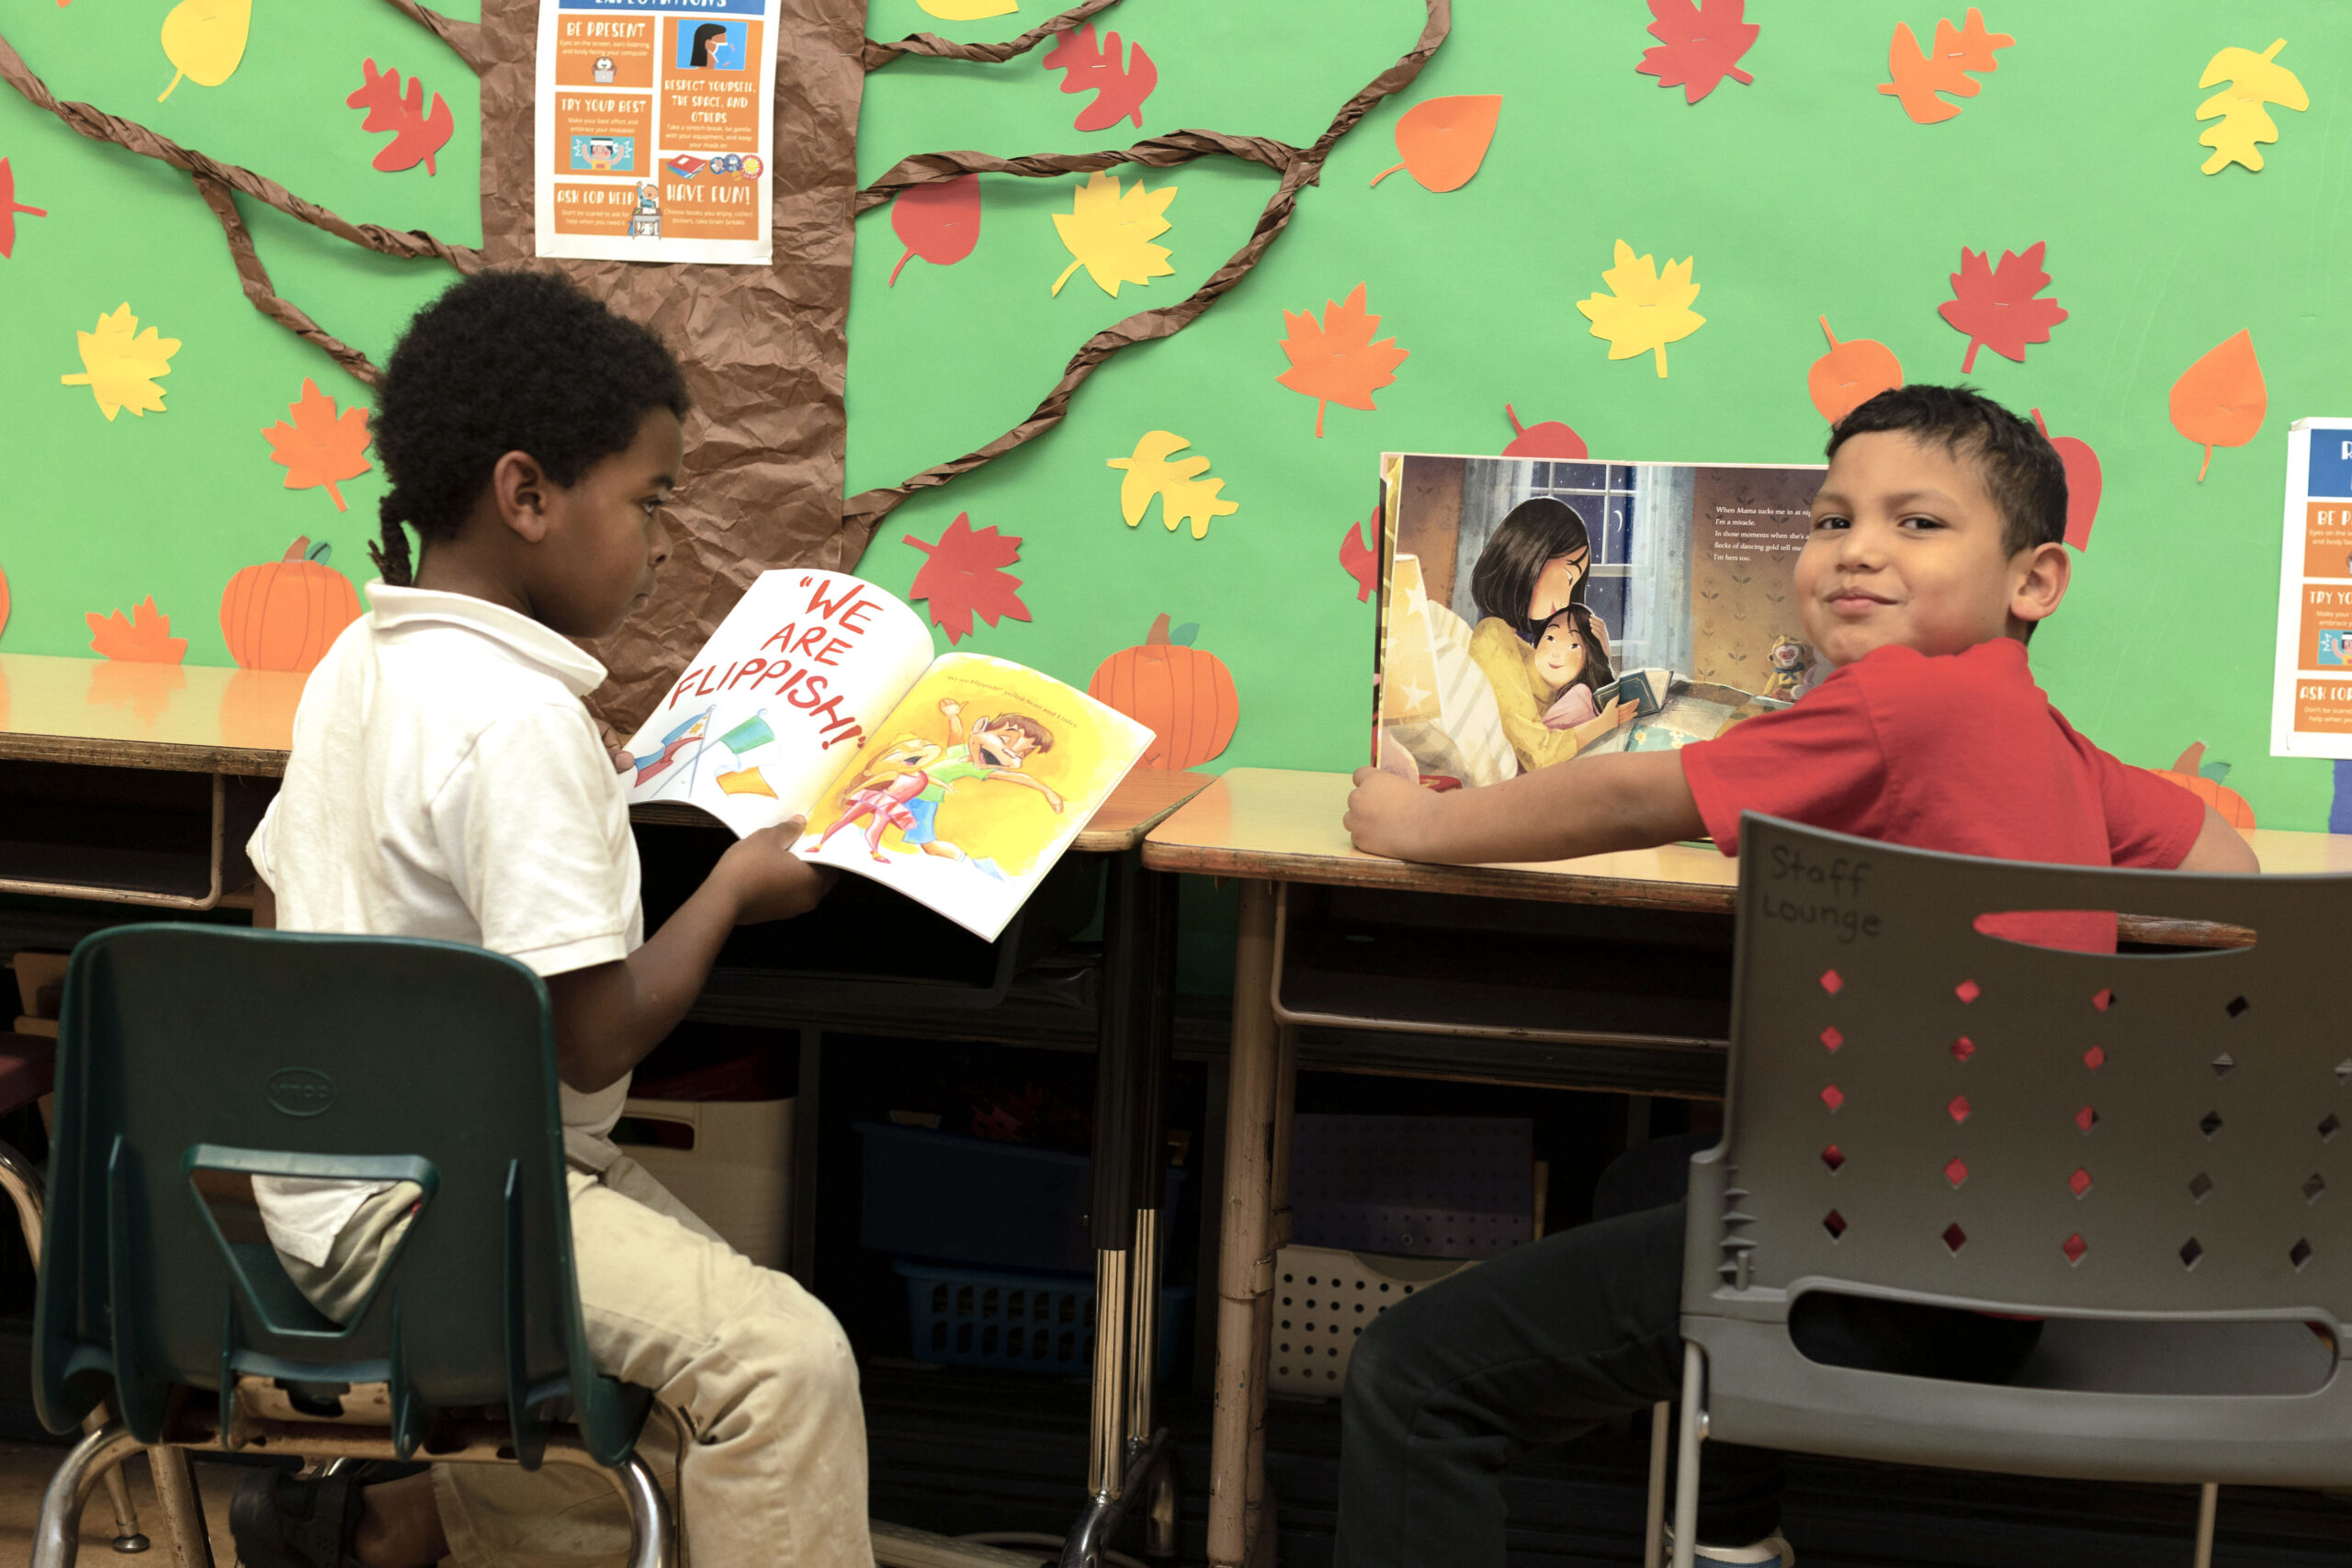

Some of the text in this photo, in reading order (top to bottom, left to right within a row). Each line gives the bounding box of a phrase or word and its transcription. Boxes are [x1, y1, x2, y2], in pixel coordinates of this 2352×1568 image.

[567, 22, 646, 38] BE PRESENT
[664, 79, 756, 94] RESPECT YOURSELF,
[561, 98, 647, 114] TRY YOUR BEST
[672, 95, 688, 107] THE
[727, 96, 748, 108] AND
[691, 111, 728, 123] OTHERS
[557, 189, 635, 205] ASK FOR HELP
[666, 183, 750, 206] HAVE FUN!
[2317, 510, 2336, 525] BE
[2309, 528, 2324, 536] Eyes
[1740, 543, 1764, 552] dancing
[1765, 544, 1780, 552] gold
[2325, 538, 2342, 547] body
[2310, 591, 2333, 604] TRY
[760, 622, 854, 667] ARE
[2300, 685, 2325, 701] ASK
[1043, 708, 1057, 717] and
[2308, 715, 2324, 723] help
[1770, 844, 1873, 897] Staff
[1762, 894, 1881, 943] Lounge
